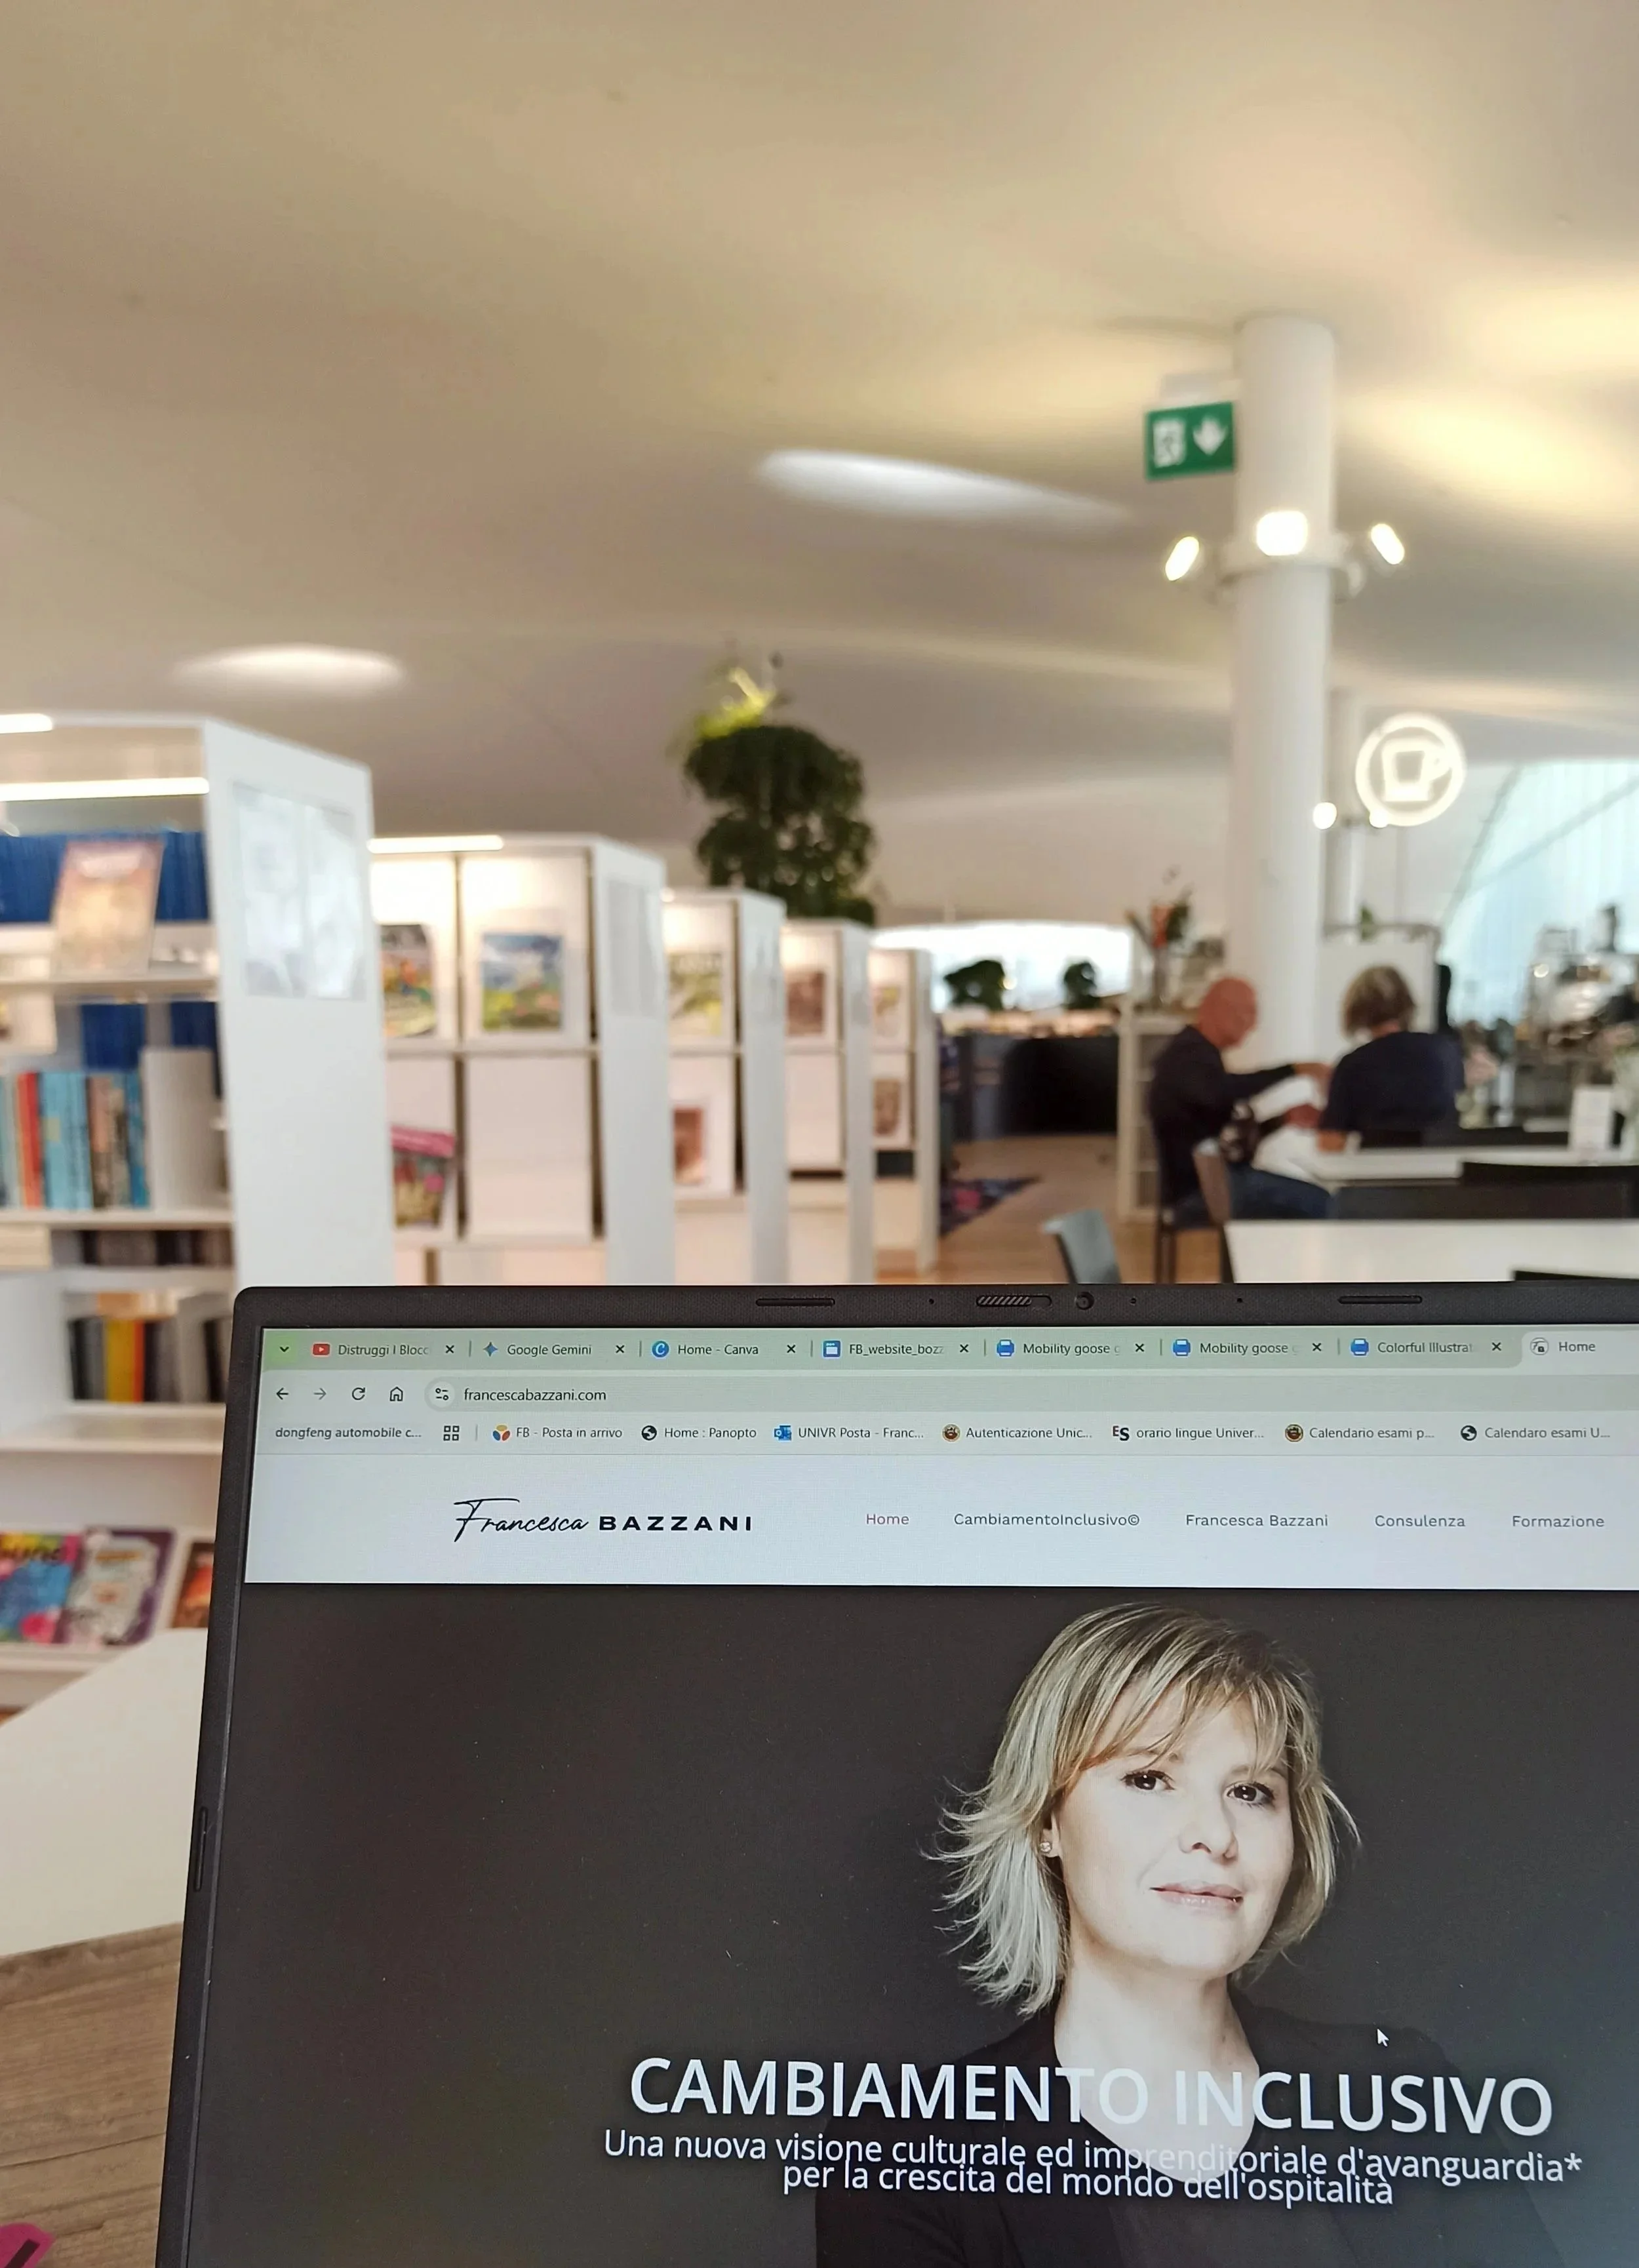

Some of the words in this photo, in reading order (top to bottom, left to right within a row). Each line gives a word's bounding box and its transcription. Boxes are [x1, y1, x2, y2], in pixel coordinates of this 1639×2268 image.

[338, 1345, 389, 1357] Distruggi
[507, 1345, 548, 1357] Google
[552, 1345, 591, 1355] Gemini
[678, 1345, 712, 1355] Home
[724, 1344, 758, 1355] Canva
[1023, 1343, 1071, 1356] Mobility
[1075, 1345, 1110, 1356] goose
[1200, 1343, 1248, 1355] Mobility
[1252, 1345, 1288, 1355] goose
[1377, 1342, 1425, 1353] Colorful
[1559, 1342, 1596, 1351] Home
[464, 1388, 606, 1401] francescabazzani.com
[275, 1427, 332, 1440] dongfeng
[335, 1427, 402, 1437] automobile
[517, 1427, 529, 1437] FB
[543, 1427, 572, 1437] Posta
[577, 1428, 586, 1437] in
[590, 1428, 622, 1437] arrivo
[665, 1428, 698, 1438] Home
[709, 1427, 757, 1440] Panopto
[799, 1427, 836, 1438] UNIVR
[840, 1427, 870, 1438] Posta
[966, 1427, 1052, 1438] Autenticazione
[1113, 1425, 1130, 1441] ES
[1137, 1428, 1172, 1438] orario
[1175, 1428, 1212, 1441] lingue
[1310, 1427, 1373, 1438] Calendario
[1377, 1428, 1412, 1438] esami
[1485, 1427, 1547, 1438] Calendaro
[1551, 1428, 1587, 1438] esami
[454, 1498, 589, 1542] Francesca
[599, 1516, 751, 1531] BAZZANI
[867, 1514, 909, 1524] Home
[1187, 1515, 1263, 1526] Francesca
[1270, 1515, 1328, 1526] Bazzani
[1375, 1515, 1465, 1526] Consulenza
[1512, 1515, 1604, 1527] Formazione
[631, 2058, 1149, 2124] CAMBIAMENTO
[1175, 2071, 1552, 2136] INCLUSIVO
[604, 2129, 663, 2158] Una
[675, 2135, 766, 2160] nuova
[776, 2132, 882, 2163] visione
[892, 2135, 1025, 2165] culturale
[1036, 2138, 1073, 2168] ed
[1084, 2138, 1327, 2175] imprenditoriale
[784, 2163, 834, 2195] per
[844, 2159, 868, 2189] la
[879, 2164, 995, 2192] crescita
[1005, 2164, 1051, 2194] del
[1062, 2170, 1174, 2198] mondo
[1184, 2170, 1393, 2208] dell'ospitalità
